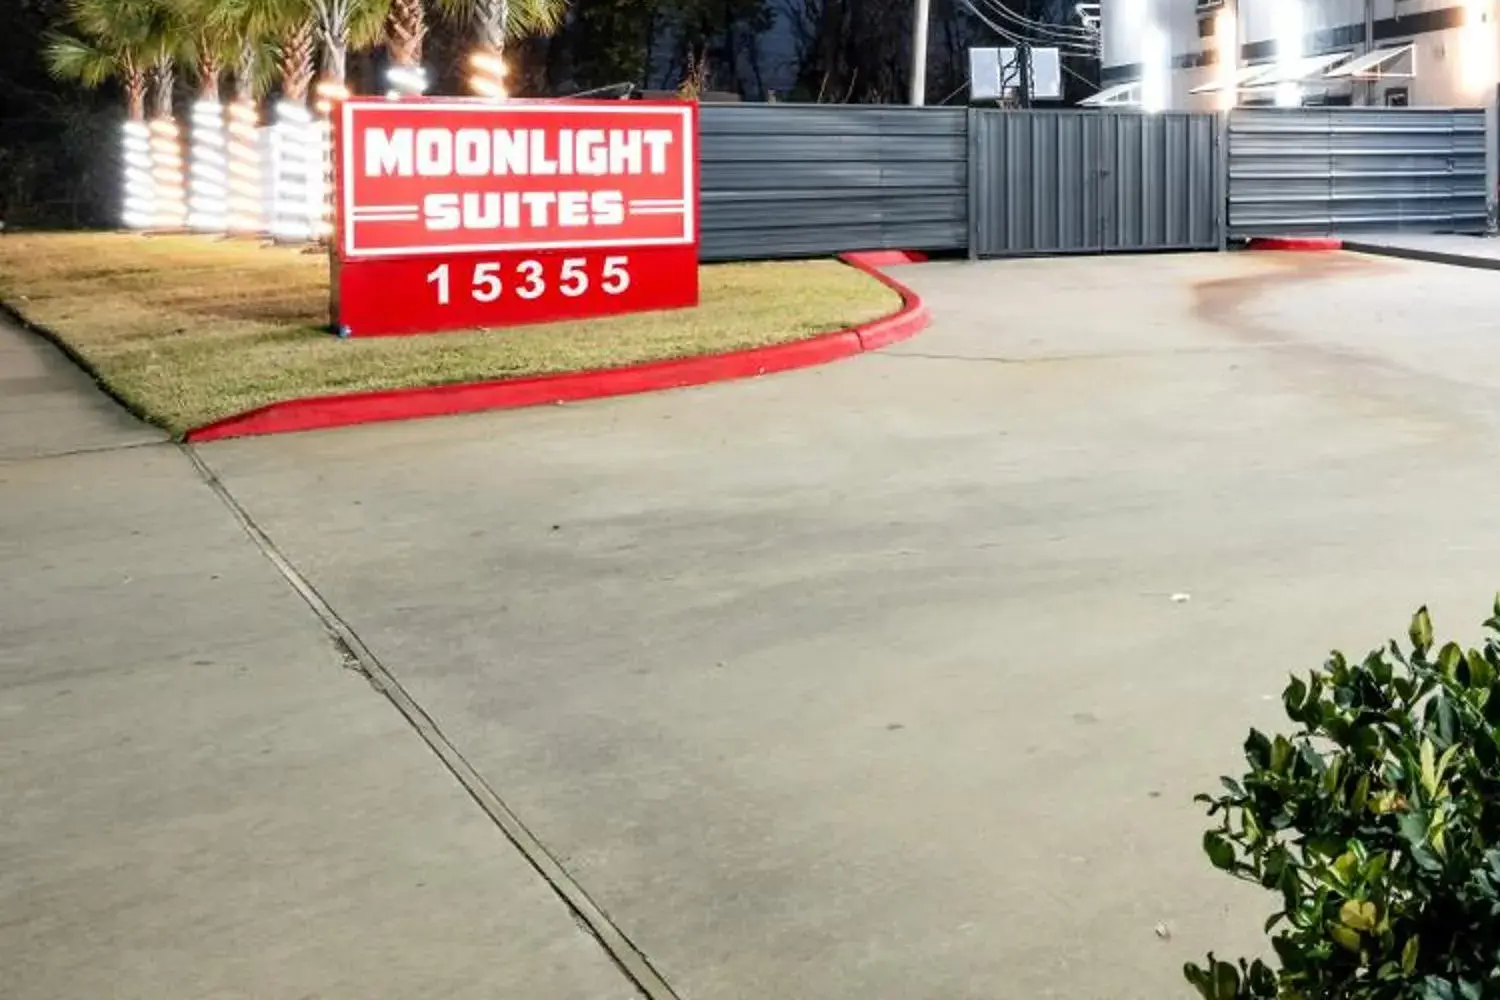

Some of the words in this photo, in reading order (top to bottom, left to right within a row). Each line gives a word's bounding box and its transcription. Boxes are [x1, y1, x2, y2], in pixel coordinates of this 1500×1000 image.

[363, 126, 674, 177] MOONLIGHT
[423, 189, 625, 232] SUITES
[426, 255, 631, 305] 15355
